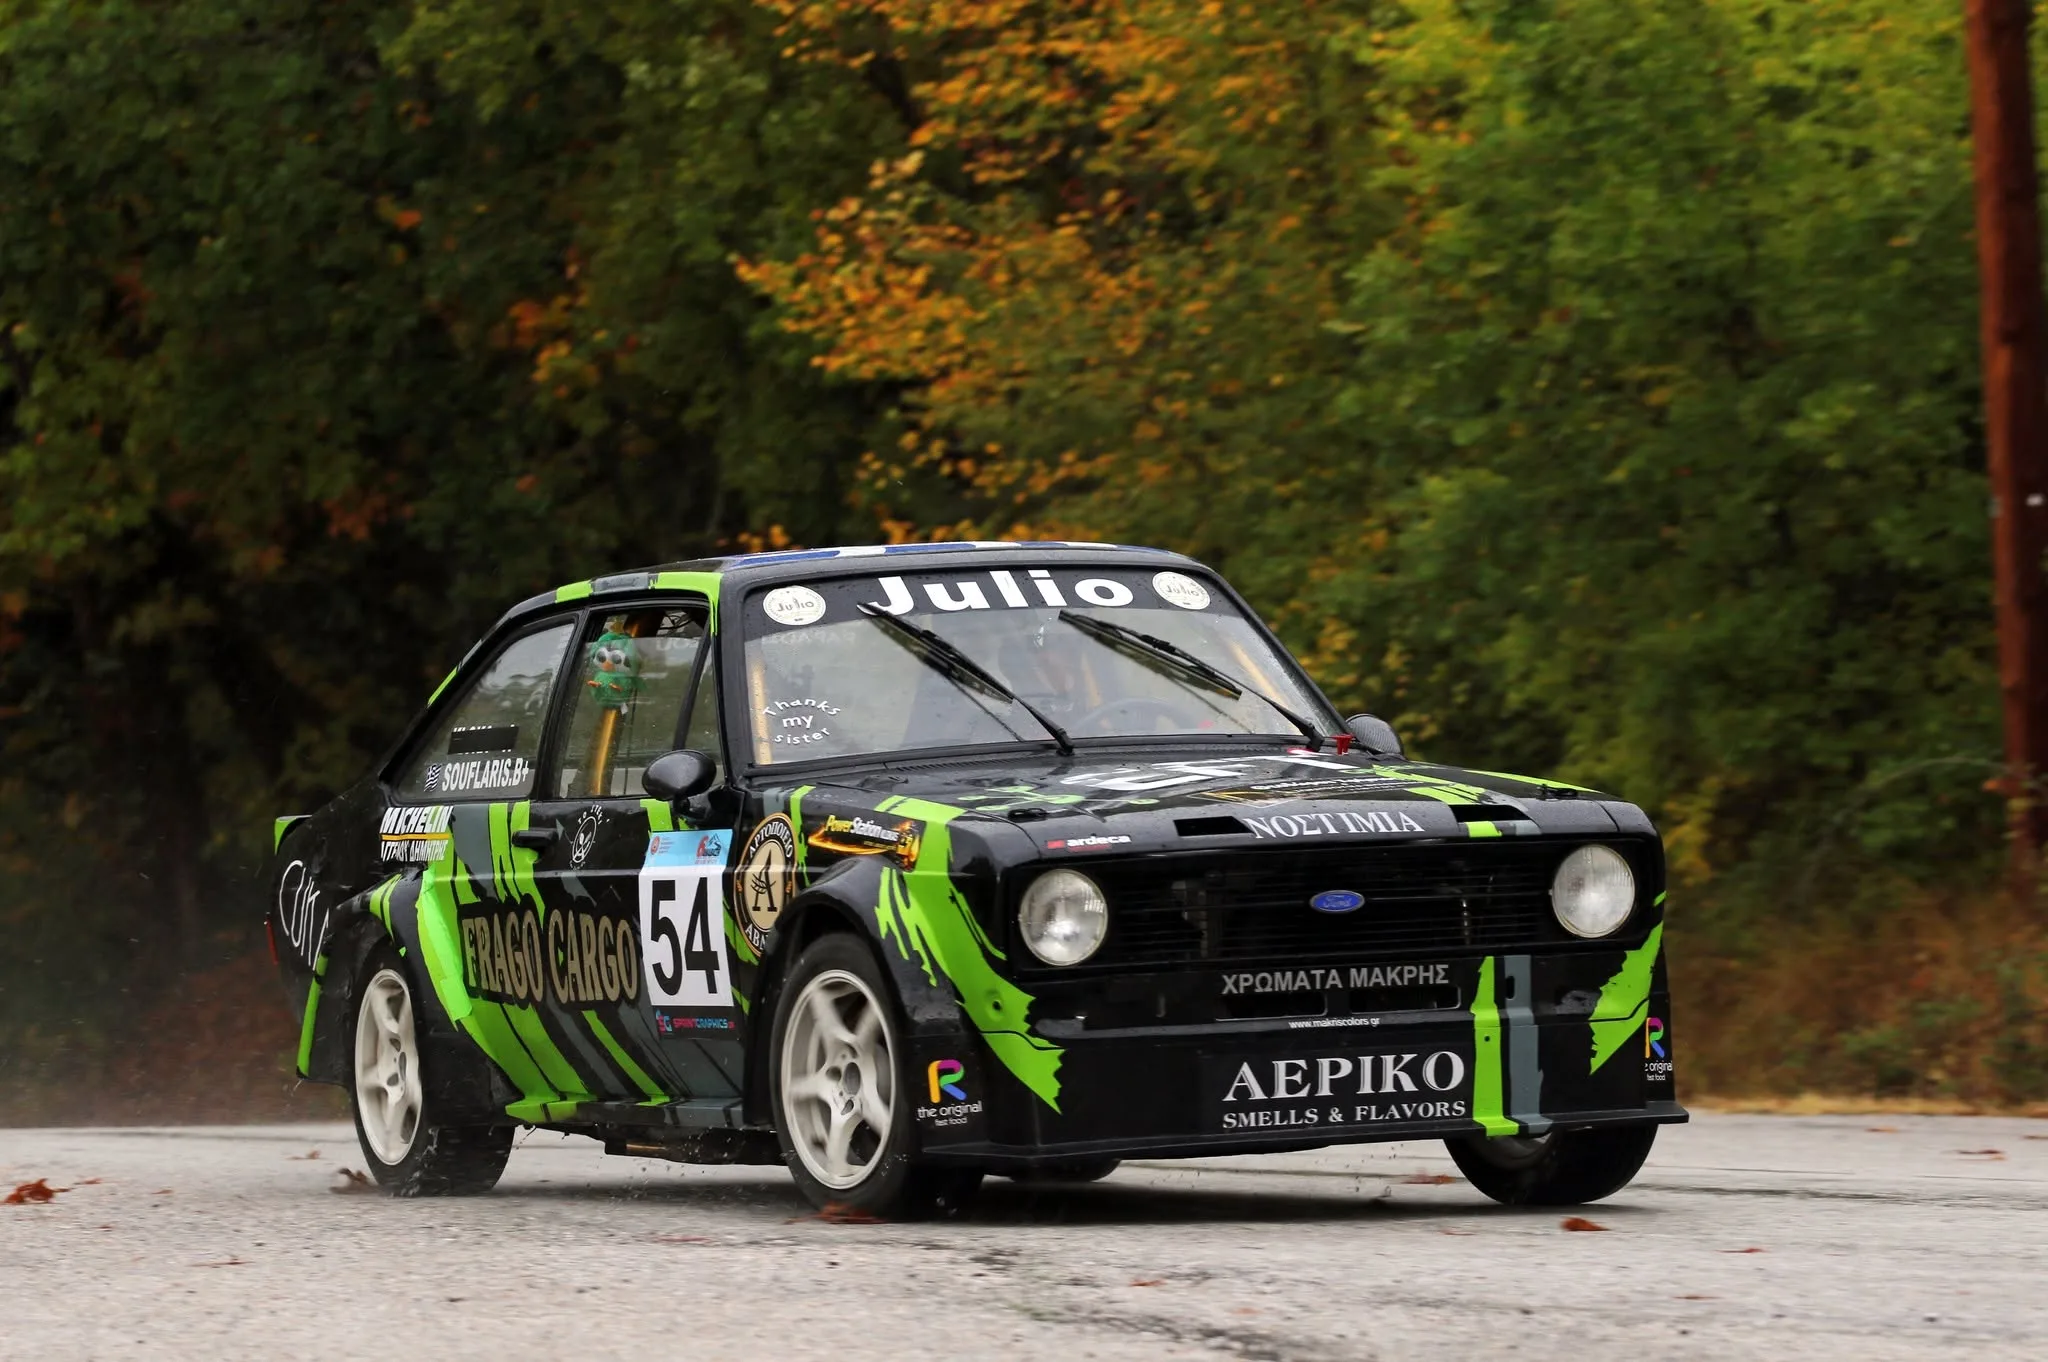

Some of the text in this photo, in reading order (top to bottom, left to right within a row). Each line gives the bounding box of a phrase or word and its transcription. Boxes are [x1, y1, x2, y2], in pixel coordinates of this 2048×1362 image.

[777, 596, 815, 612] Julio
[856, 570, 1134, 616] Julio
[763, 699, 841, 717] Thanks
[782, 714, 814, 729] my
[774, 727, 831, 745] sister
[380, 805, 455, 834] MICHELIN
[1246, 811, 1425, 839] ΝΟΣΤΙΜΙΑ
[749, 821, 794, 858] ΑΡΤΟΠΟΙΕΙΟ
[1067, 836, 1131, 847] ardeca
[650, 877, 720, 996] 54
[461, 909, 638, 1004] FRAGO CARGO
[1221, 964, 1449, 995] ΧΡΩΜΑΤΑ ΜΑΚΡΗΣ
[1288, 1016, 1381, 1030] www.makriscolorsgr
[917, 1100, 983, 1119] the original
[1223, 1100, 1466, 1129] SMELLS & FLAVORS
